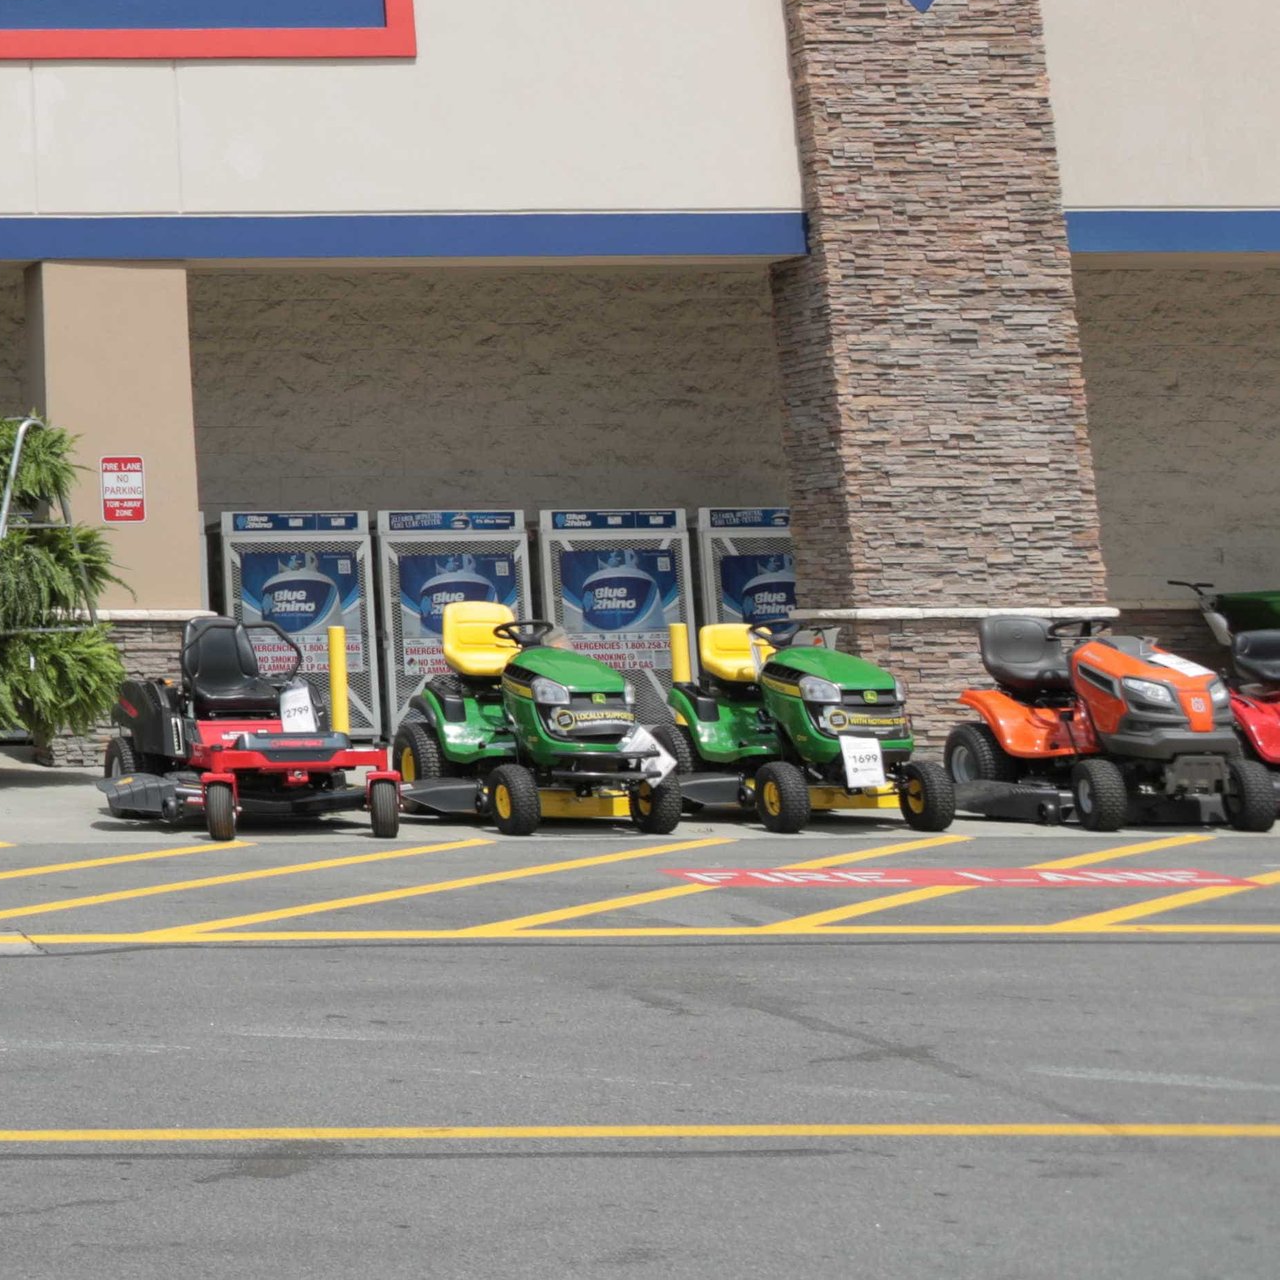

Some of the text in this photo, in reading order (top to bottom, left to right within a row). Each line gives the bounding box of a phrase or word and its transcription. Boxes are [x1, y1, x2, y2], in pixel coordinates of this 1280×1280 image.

[102, 462, 142, 470] FIRE LANE
[116, 474, 129, 483] NO
[104, 486, 142, 495] PARKING
[115, 509, 133, 517] ZONE
[274, 589, 306, 601] Blue
[595, 586, 627, 597] Blue
[432, 591, 465, 603] Blue
[754, 592, 786, 602] Blue
[272, 601, 315, 613] Rhino
[593, 598, 636, 610] Rhino
[571, 641, 623, 650] MERGENCIES:
[258, 656, 269, 664] NO
[306, 663, 315, 671] LP
[629, 661, 638, 669] LP
[638, 661, 654, 669] GAS
[683, 871, 1233, 885] FIRE LANE
